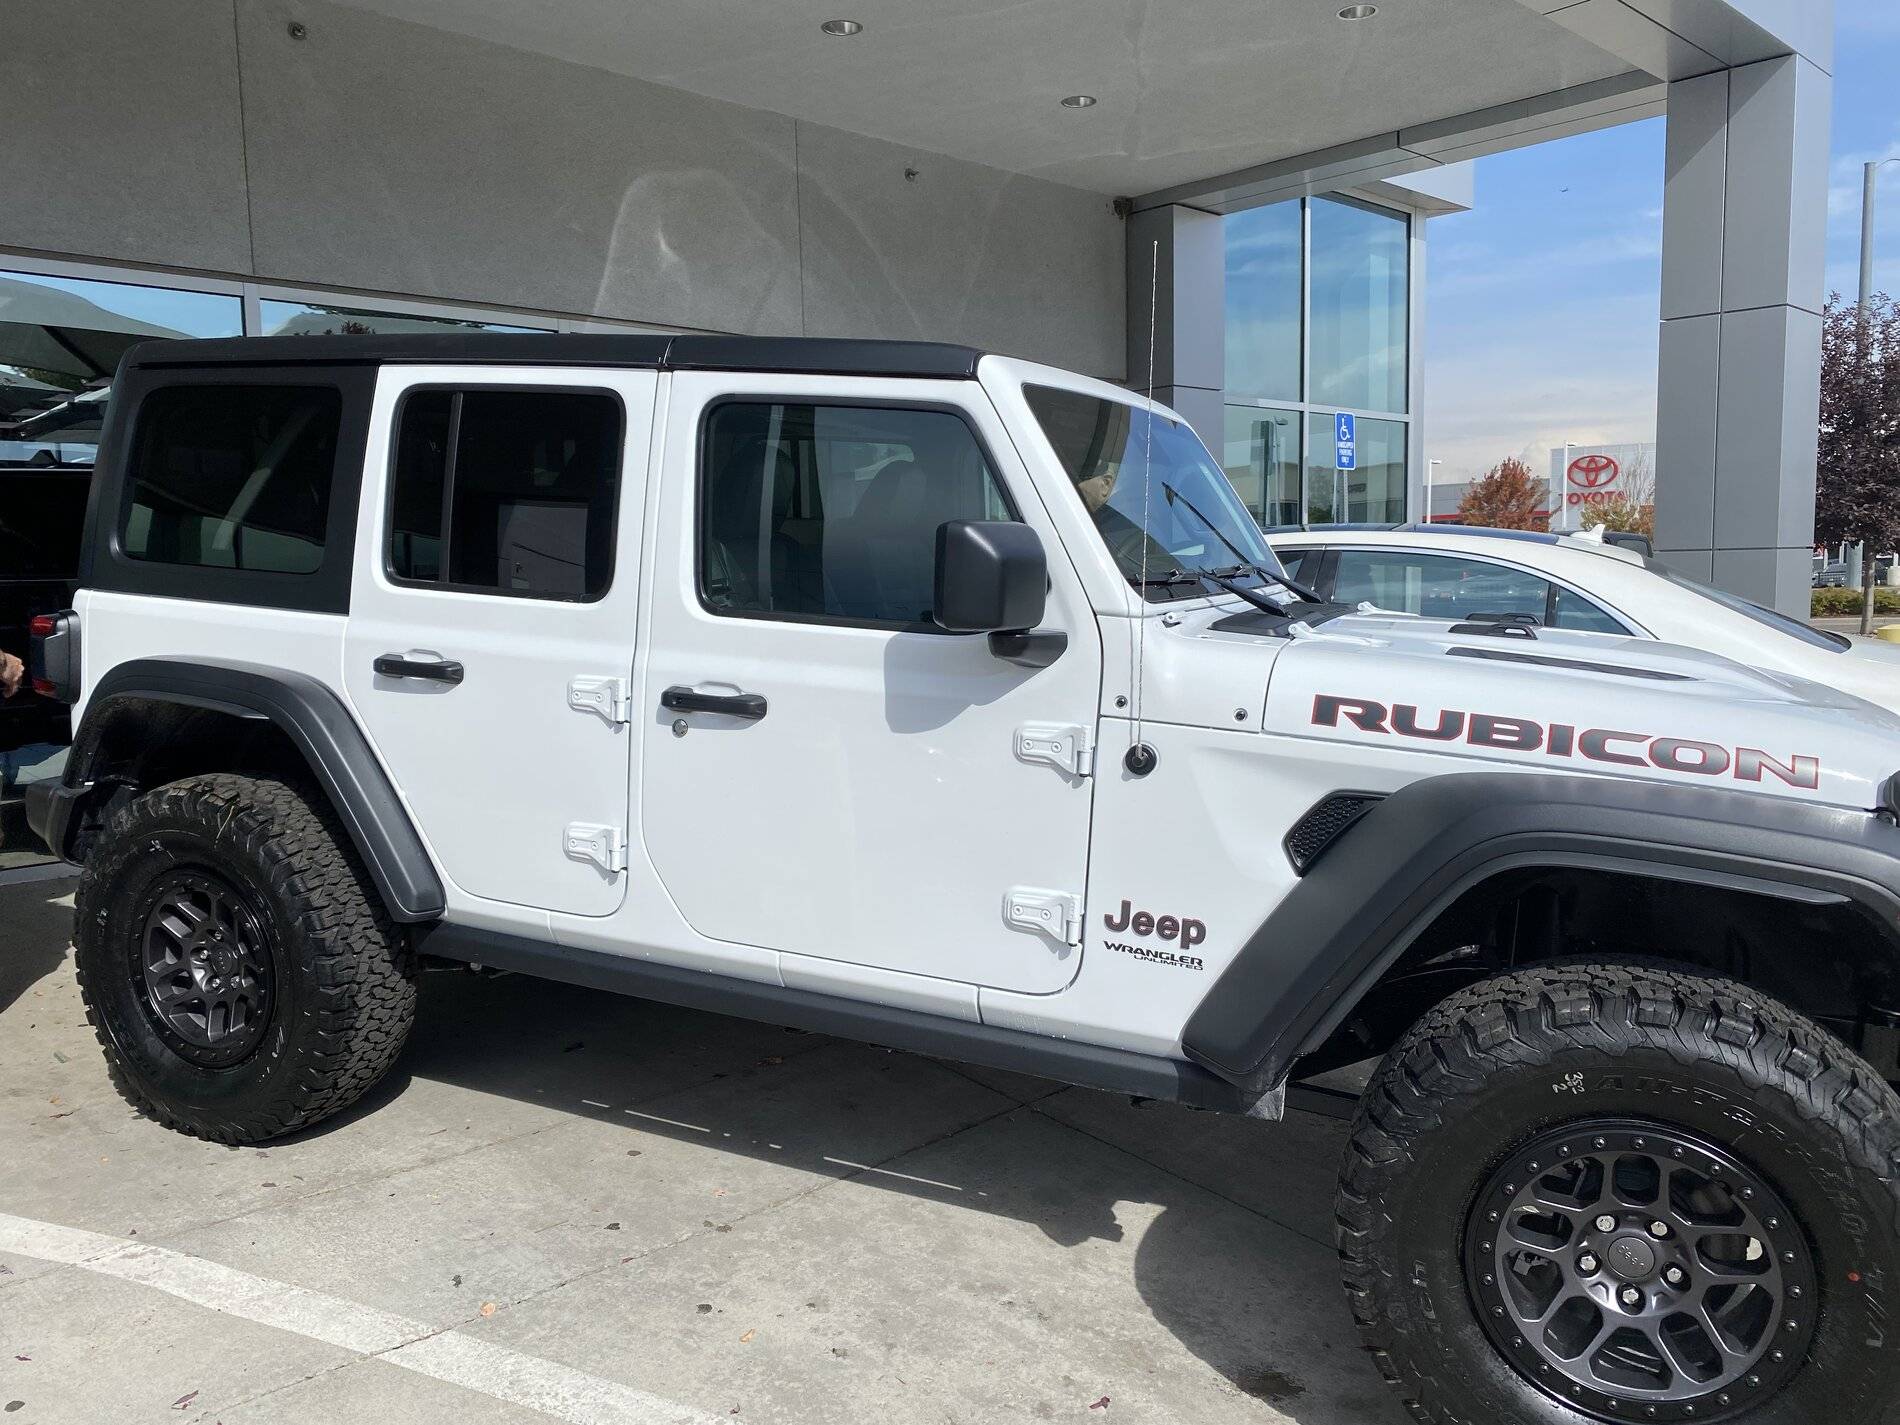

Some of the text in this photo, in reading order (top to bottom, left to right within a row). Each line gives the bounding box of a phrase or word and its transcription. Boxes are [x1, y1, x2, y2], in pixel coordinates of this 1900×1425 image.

[1311, 694, 1820, 790] RUBICON
[1104, 899, 1206, 950] Jeep
[1103, 940, 1204, 967] WRANGLER
[1133, 954, 1204, 971] UNLIMITED
